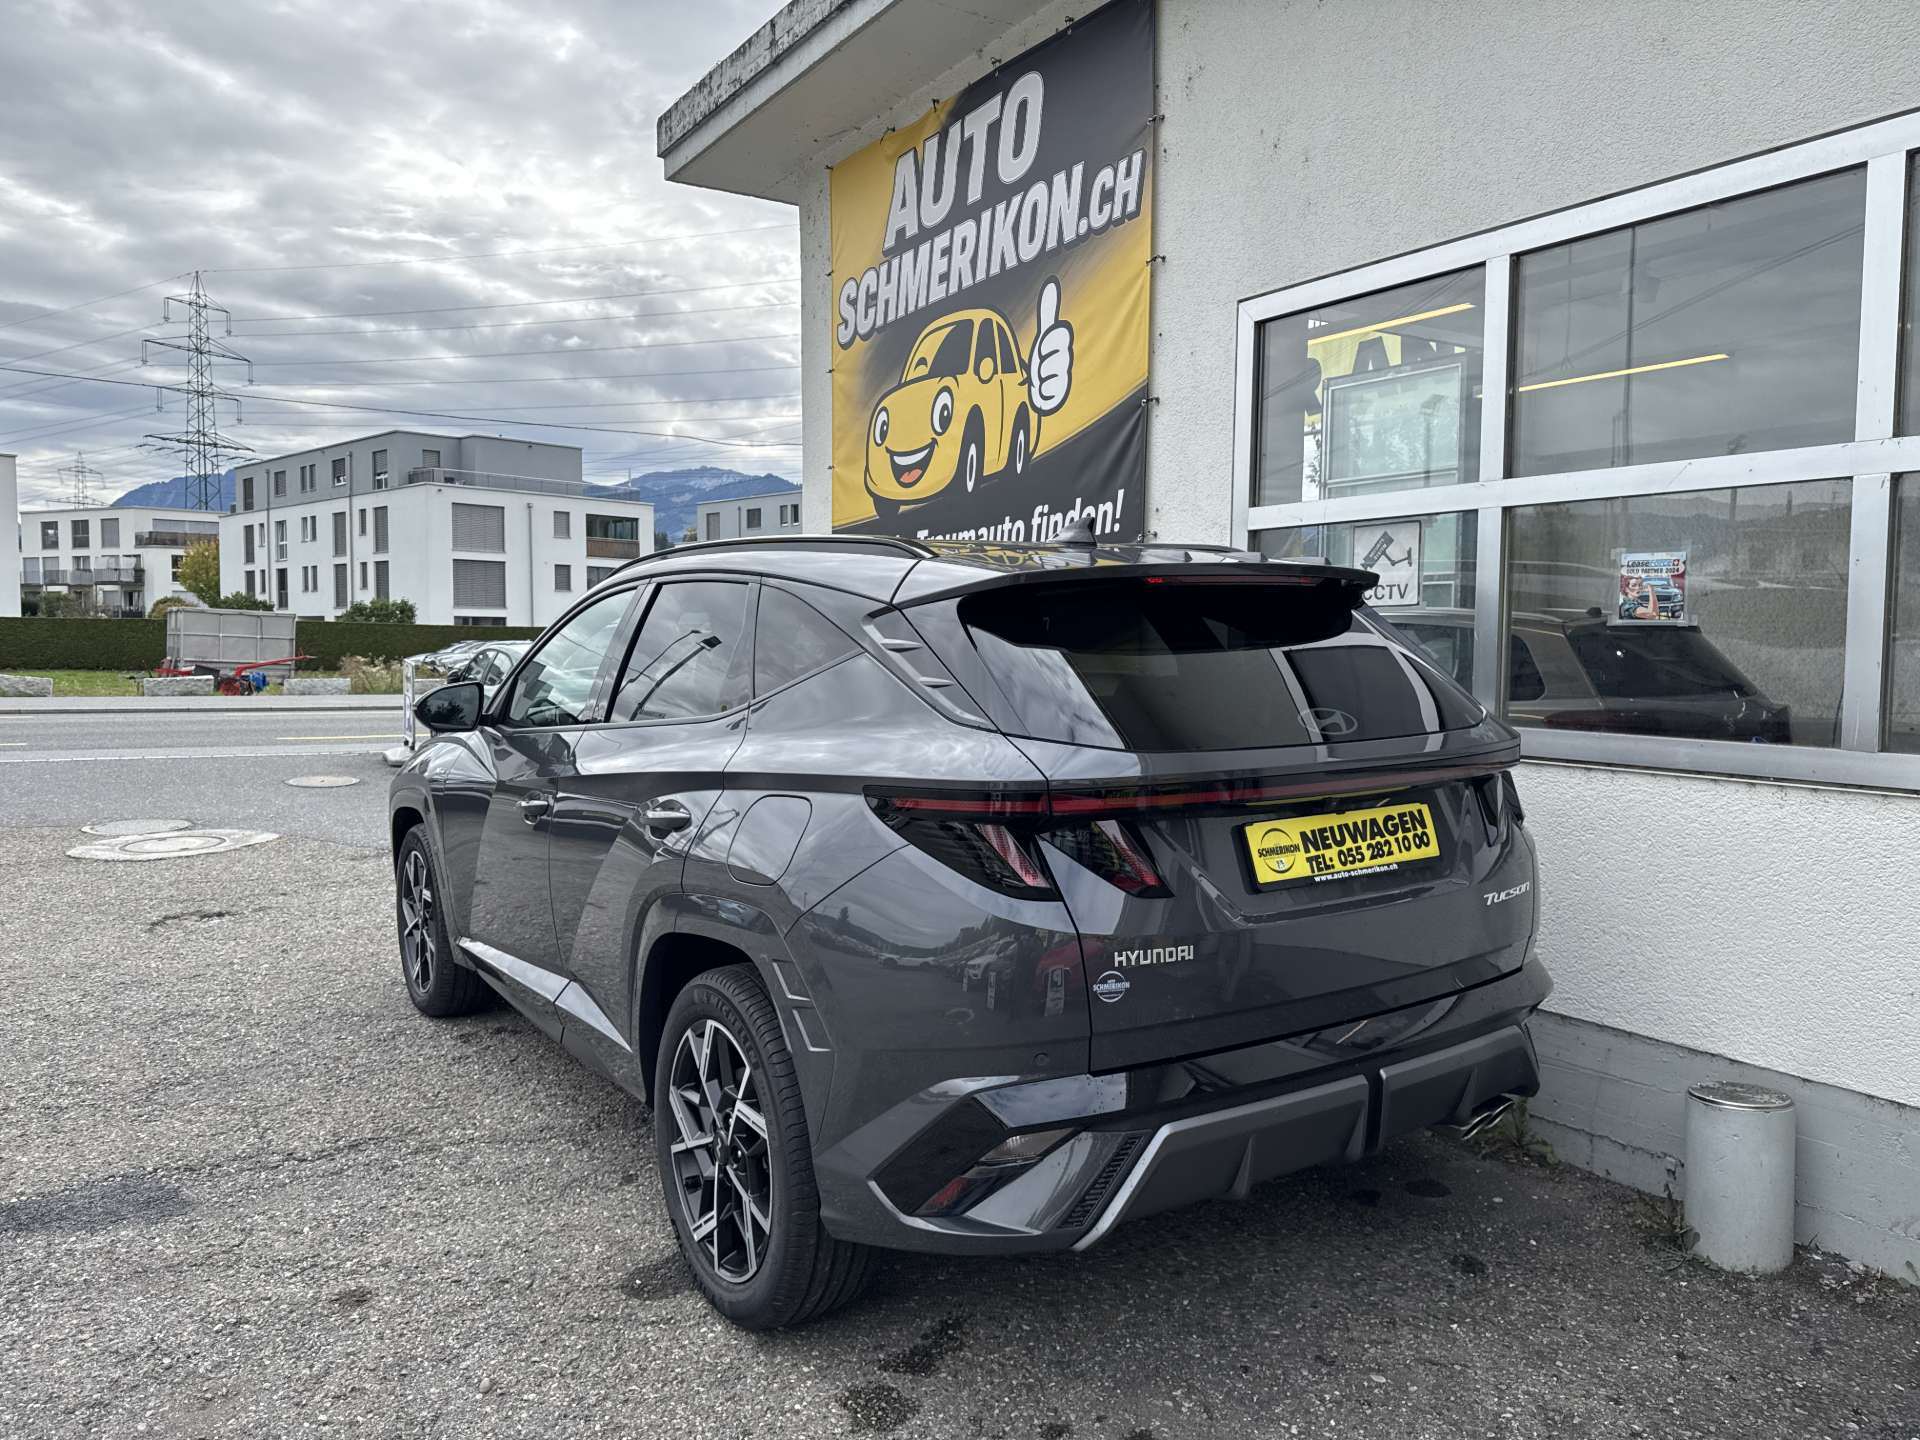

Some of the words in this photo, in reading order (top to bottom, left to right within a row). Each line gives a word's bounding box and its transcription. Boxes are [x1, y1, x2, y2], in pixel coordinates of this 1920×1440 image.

[882, 71, 1044, 251] AUTO
[837, 150, 1145, 346] SCHMERIKON.CH
[917, 516, 1025, 542] mauto
[1300, 809, 1428, 853] NEUWAGEN
[1306, 853, 1335, 874] TEL:
[1337, 845, 1366, 867] 055
[1366, 839, 1395, 861] 282
[1394, 834, 1412, 854] 10
[1412, 830, 1431, 849] 00
[1314, 863, 1398, 882] www.auto-schmerikon.ch
[1483, 881, 1530, 906] TUCSON
[1114, 945, 1194, 967] HYUNDAI
